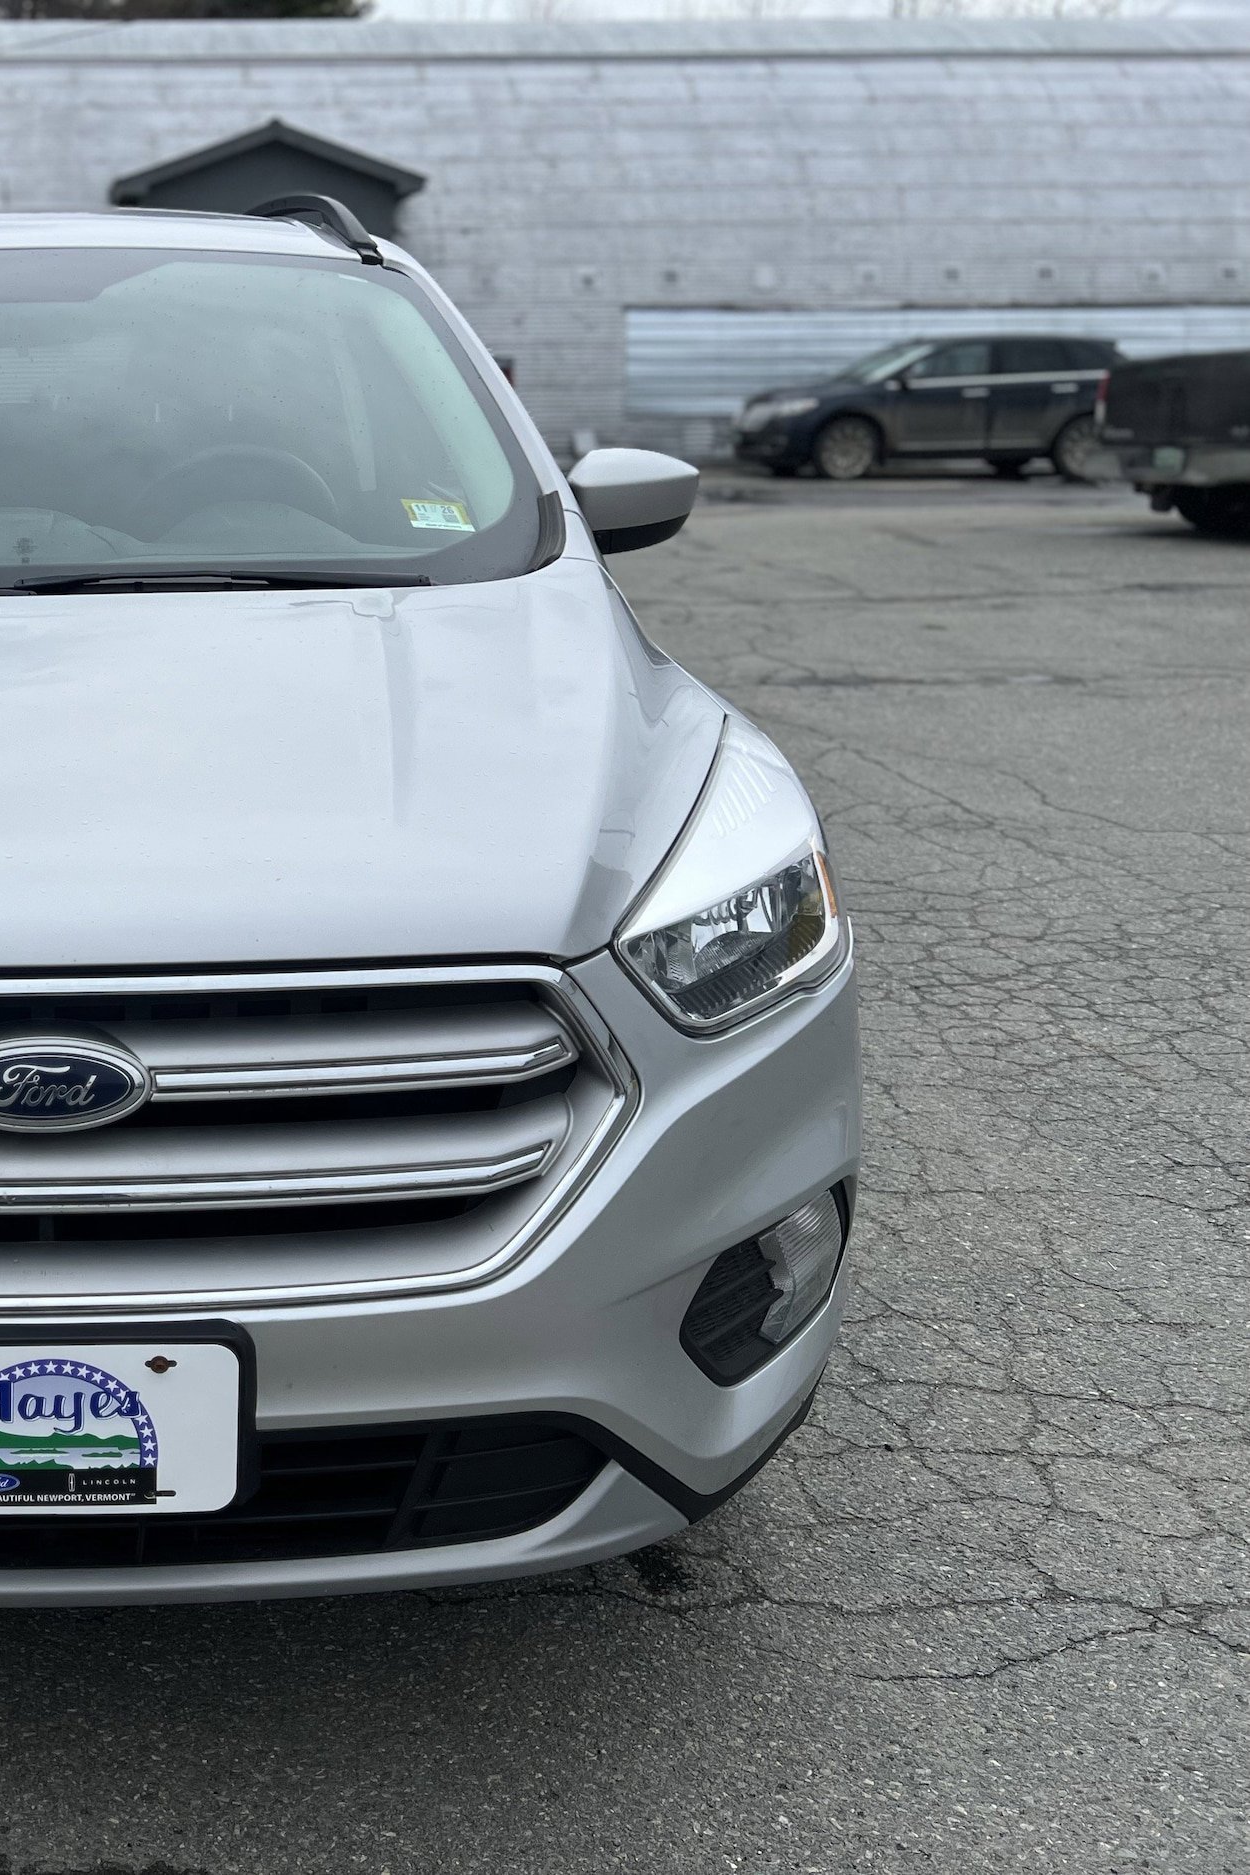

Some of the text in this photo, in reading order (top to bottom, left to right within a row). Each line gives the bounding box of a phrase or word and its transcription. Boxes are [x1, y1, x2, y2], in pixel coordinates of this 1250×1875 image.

[415, 504, 427, 513] 11
[37, 1493, 85, 1502] NEWPORT,
[85, 1493, 136, 1501] VERMONT"
